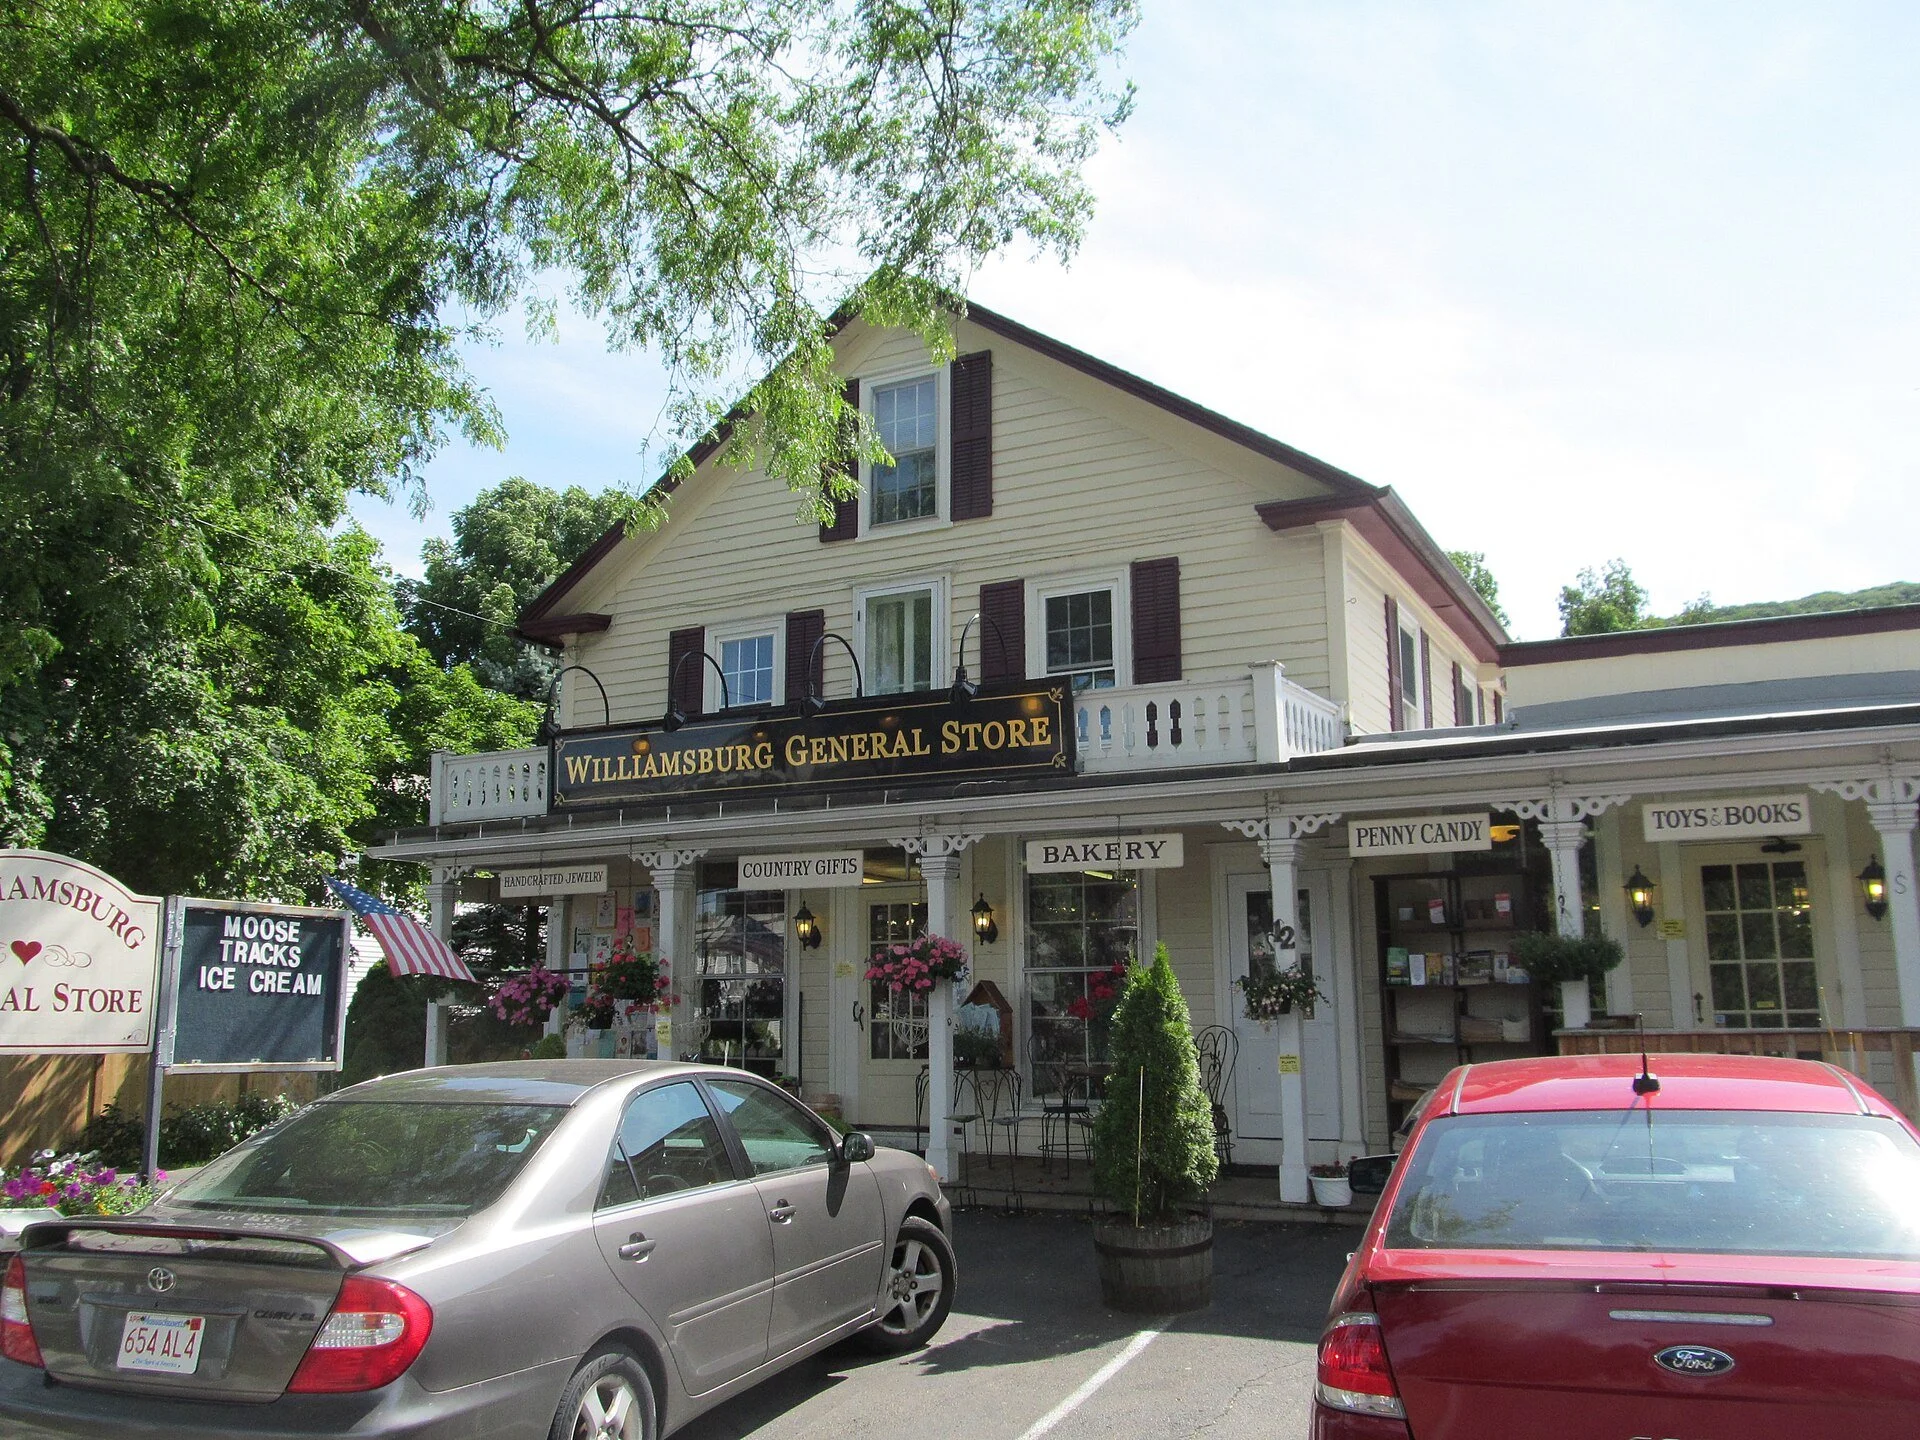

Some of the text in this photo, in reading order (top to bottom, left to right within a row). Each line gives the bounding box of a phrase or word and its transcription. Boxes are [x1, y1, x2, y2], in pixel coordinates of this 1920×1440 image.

[565, 717, 1052, 784] WILLIAMSBURG GENERAL STORE
[1652, 808, 1708, 829] TOYS
[1724, 803, 1801, 826] BOOKS
[1356, 820, 1483, 848] PENNY CANDY
[1043, 840, 1167, 864] BAKERY
[504, 871, 604, 888] HANDCRAFTED JEWELRY
[743, 858, 858, 878] COUNTRY GIFTS
[224, 915, 301, 943] MOOSE
[219, 939, 302, 968] TRACKS
[200, 965, 322, 995] ICE CREAM
[53, 982, 143, 1013] STORE
[124, 1327, 197, 1359] 654 AL4
[1672, 1350, 1716, 1370] Ford
